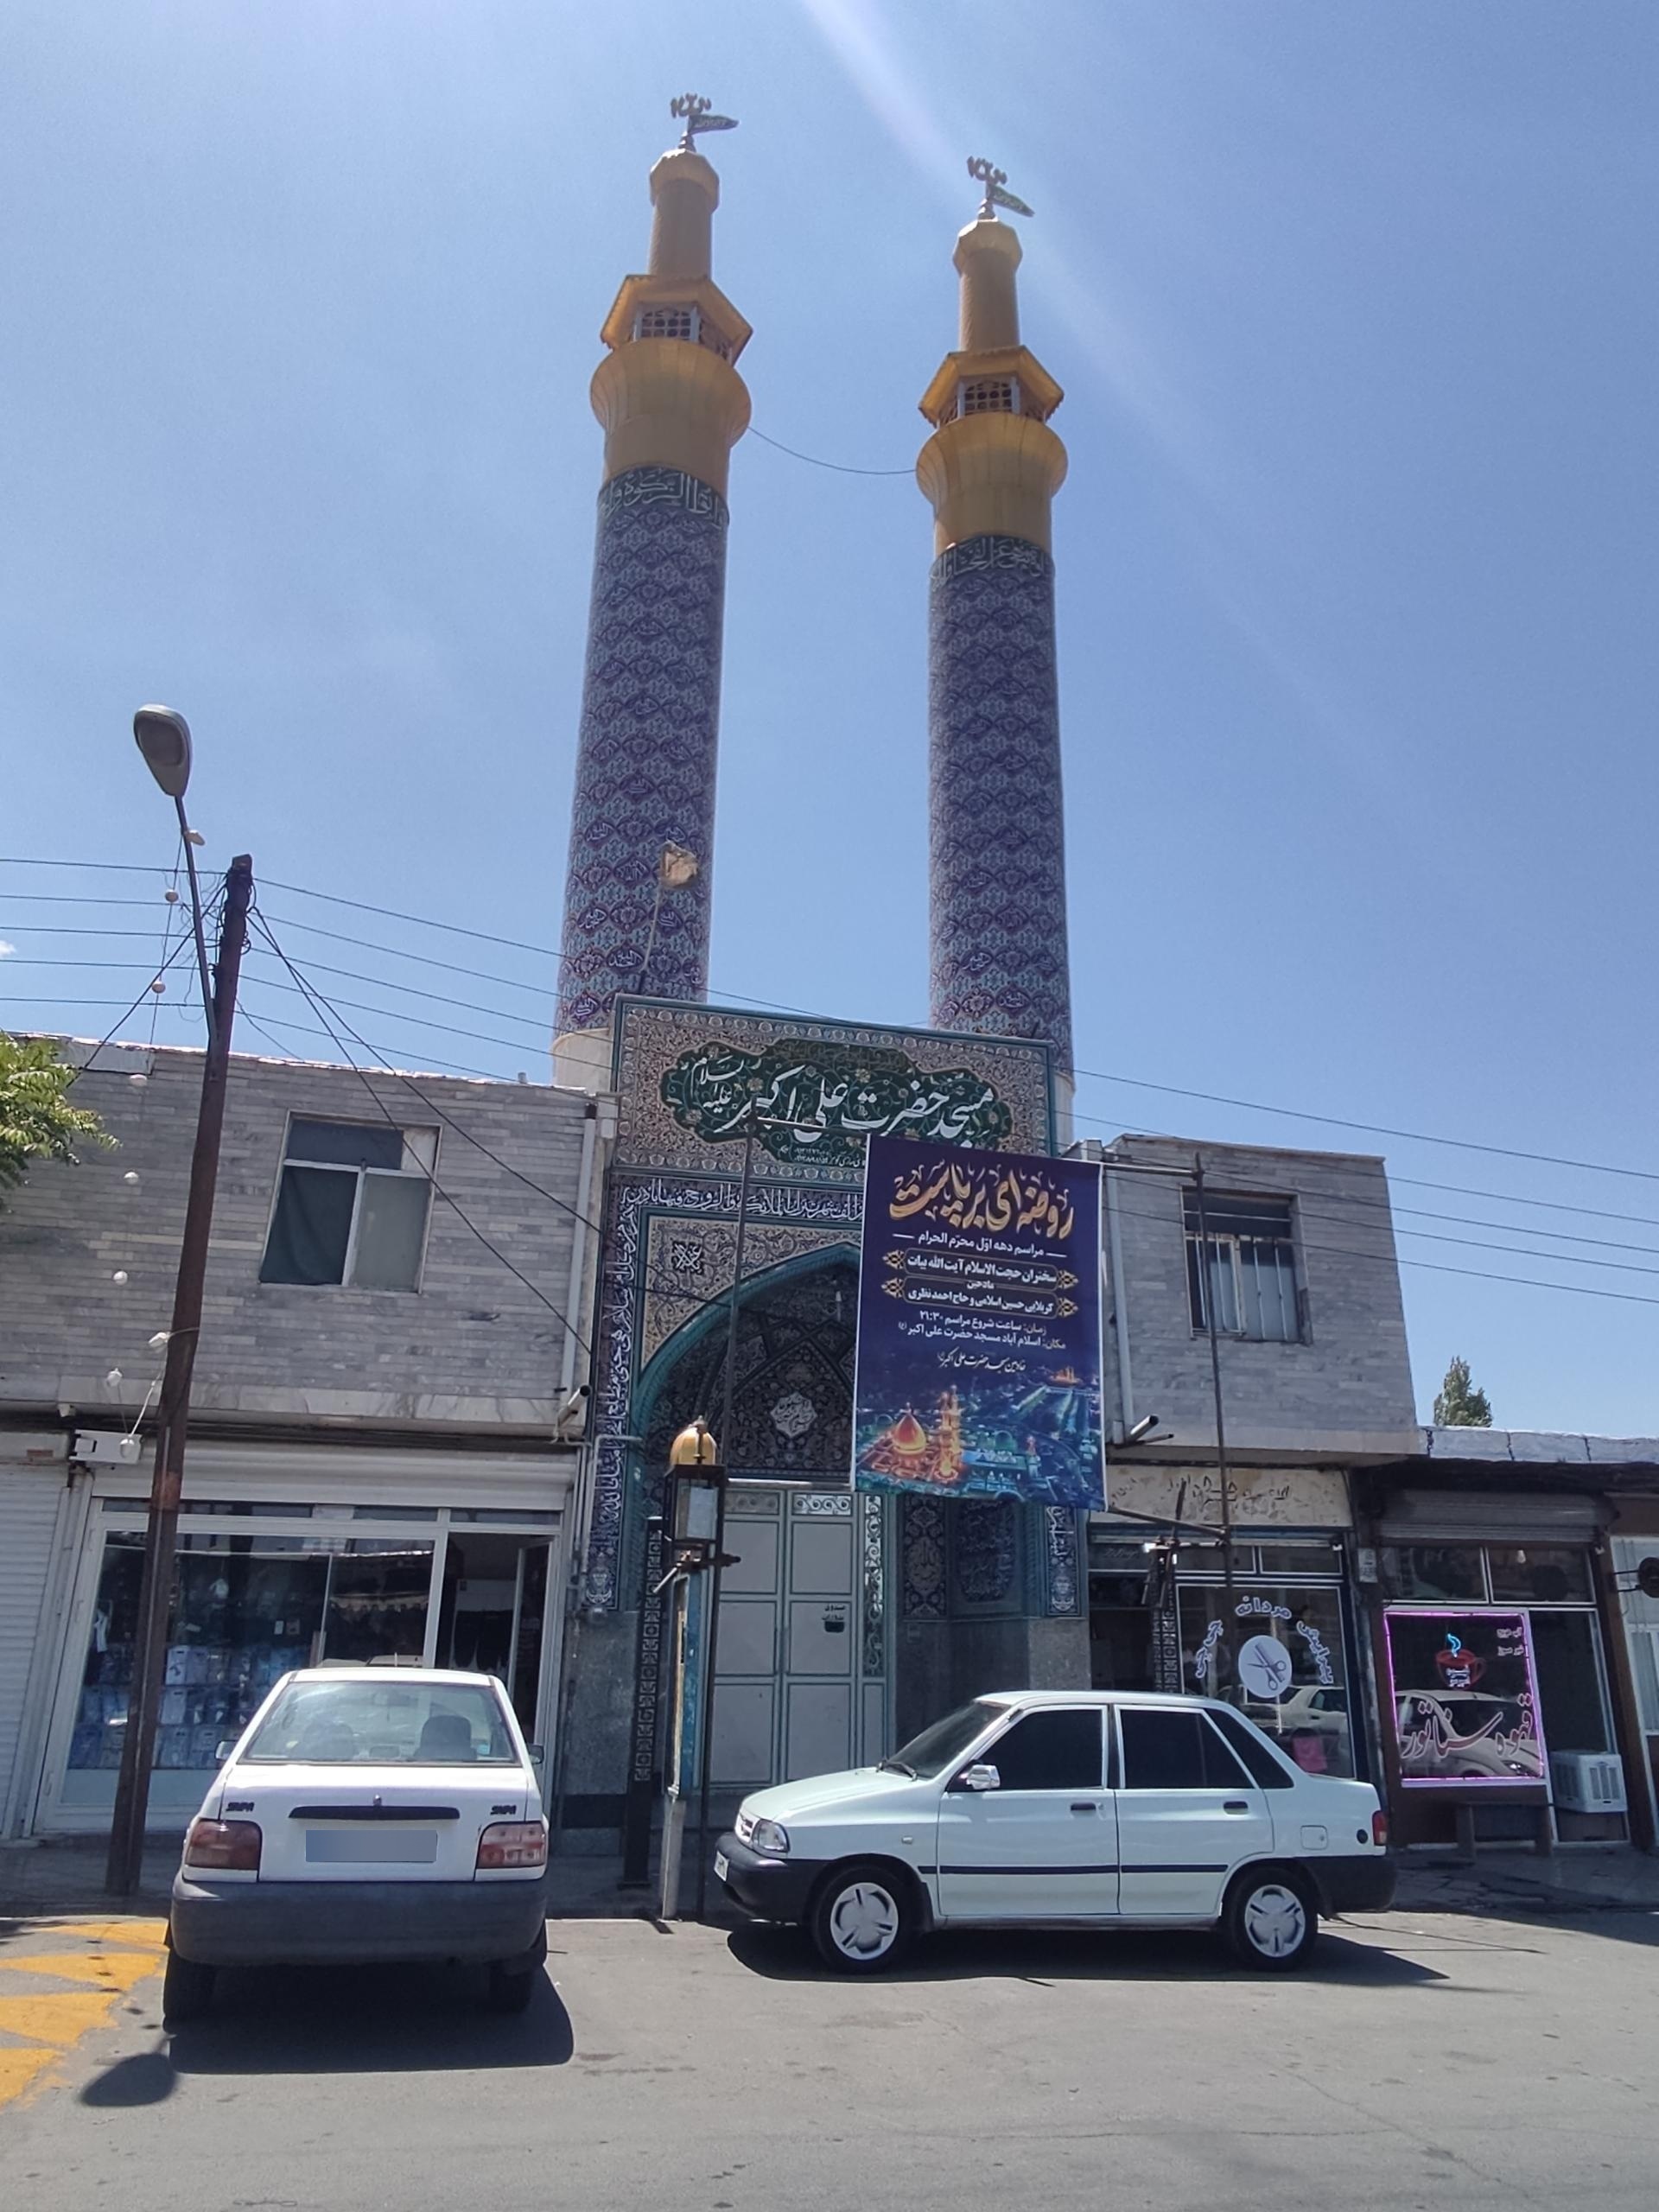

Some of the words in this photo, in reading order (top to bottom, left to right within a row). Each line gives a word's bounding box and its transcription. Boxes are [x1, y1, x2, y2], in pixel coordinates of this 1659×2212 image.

[702, 1084, 733, 1114] علیه
[714, 1064, 806, 1134] اکبر
[842, 1080, 950, 1137] حضرت
[928, 1089, 994, 1148] مسجد
[918, 1230, 948, 1245] الحرام
[994, 1241, 1013, 1252] دهه
[1014, 1243, 1045, 1258] مراسم
[907, 1254, 928, 1270] بیات
[928, 1255, 944, 1269] الله
[995, 1264, 1021, 1280] حجت
[1021, 1269, 1057, 1284] سخنران
[908, 1287, 932, 1300] نظری
[931, 1290, 952, 1301] احمد
[952, 1292, 969, 1304] حاج
[969, 1297, 975, 1306] و
[975, 1294, 1002, 1307] اسلامی
[1001, 1298, 1025, 1311] حسین
[1025, 1300, 1053, 1314] کربلایی
[944, 1313, 971, 1326] مراسم
[971, 1316, 995, 1330] شروع
[995, 1319, 1022, 1332] ساعت
[907, 1323, 925, 1336] اکبر
[925, 1325, 944, 1338] علی
[944, 1326, 973, 1339] حضرت
[974, 1331, 1001, 1344] مسجد
[1017, 1336, 1042, 1349] اسلام
[1234, 1595, 1293, 1620] مردانه
